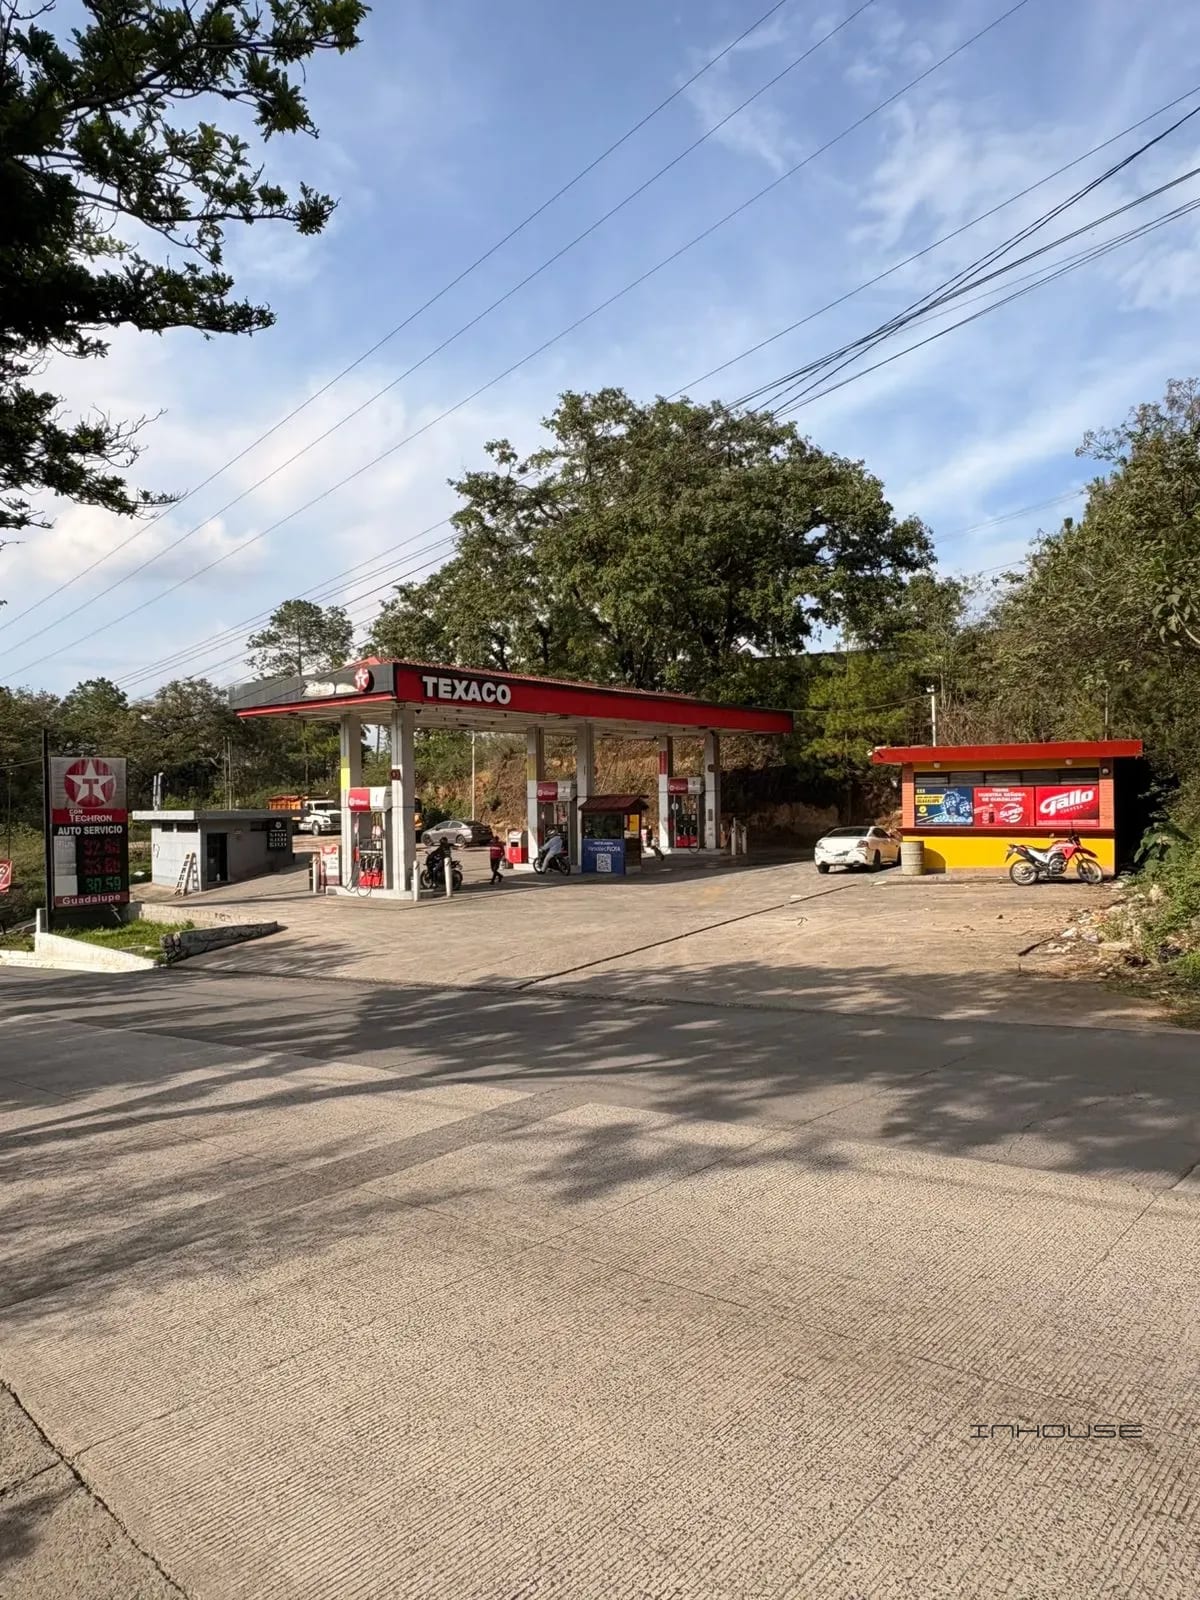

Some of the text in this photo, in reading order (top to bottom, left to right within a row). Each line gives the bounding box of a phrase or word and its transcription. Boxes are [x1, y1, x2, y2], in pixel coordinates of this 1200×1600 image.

[422, 676, 511, 704] TEXACO
[1039, 789, 1094, 816] Gallo
[70, 815, 112, 823] TECHRON
[58, 825, 123, 835] AUTO SERVICIO
[62, 894, 121, 905] Guadalupe
